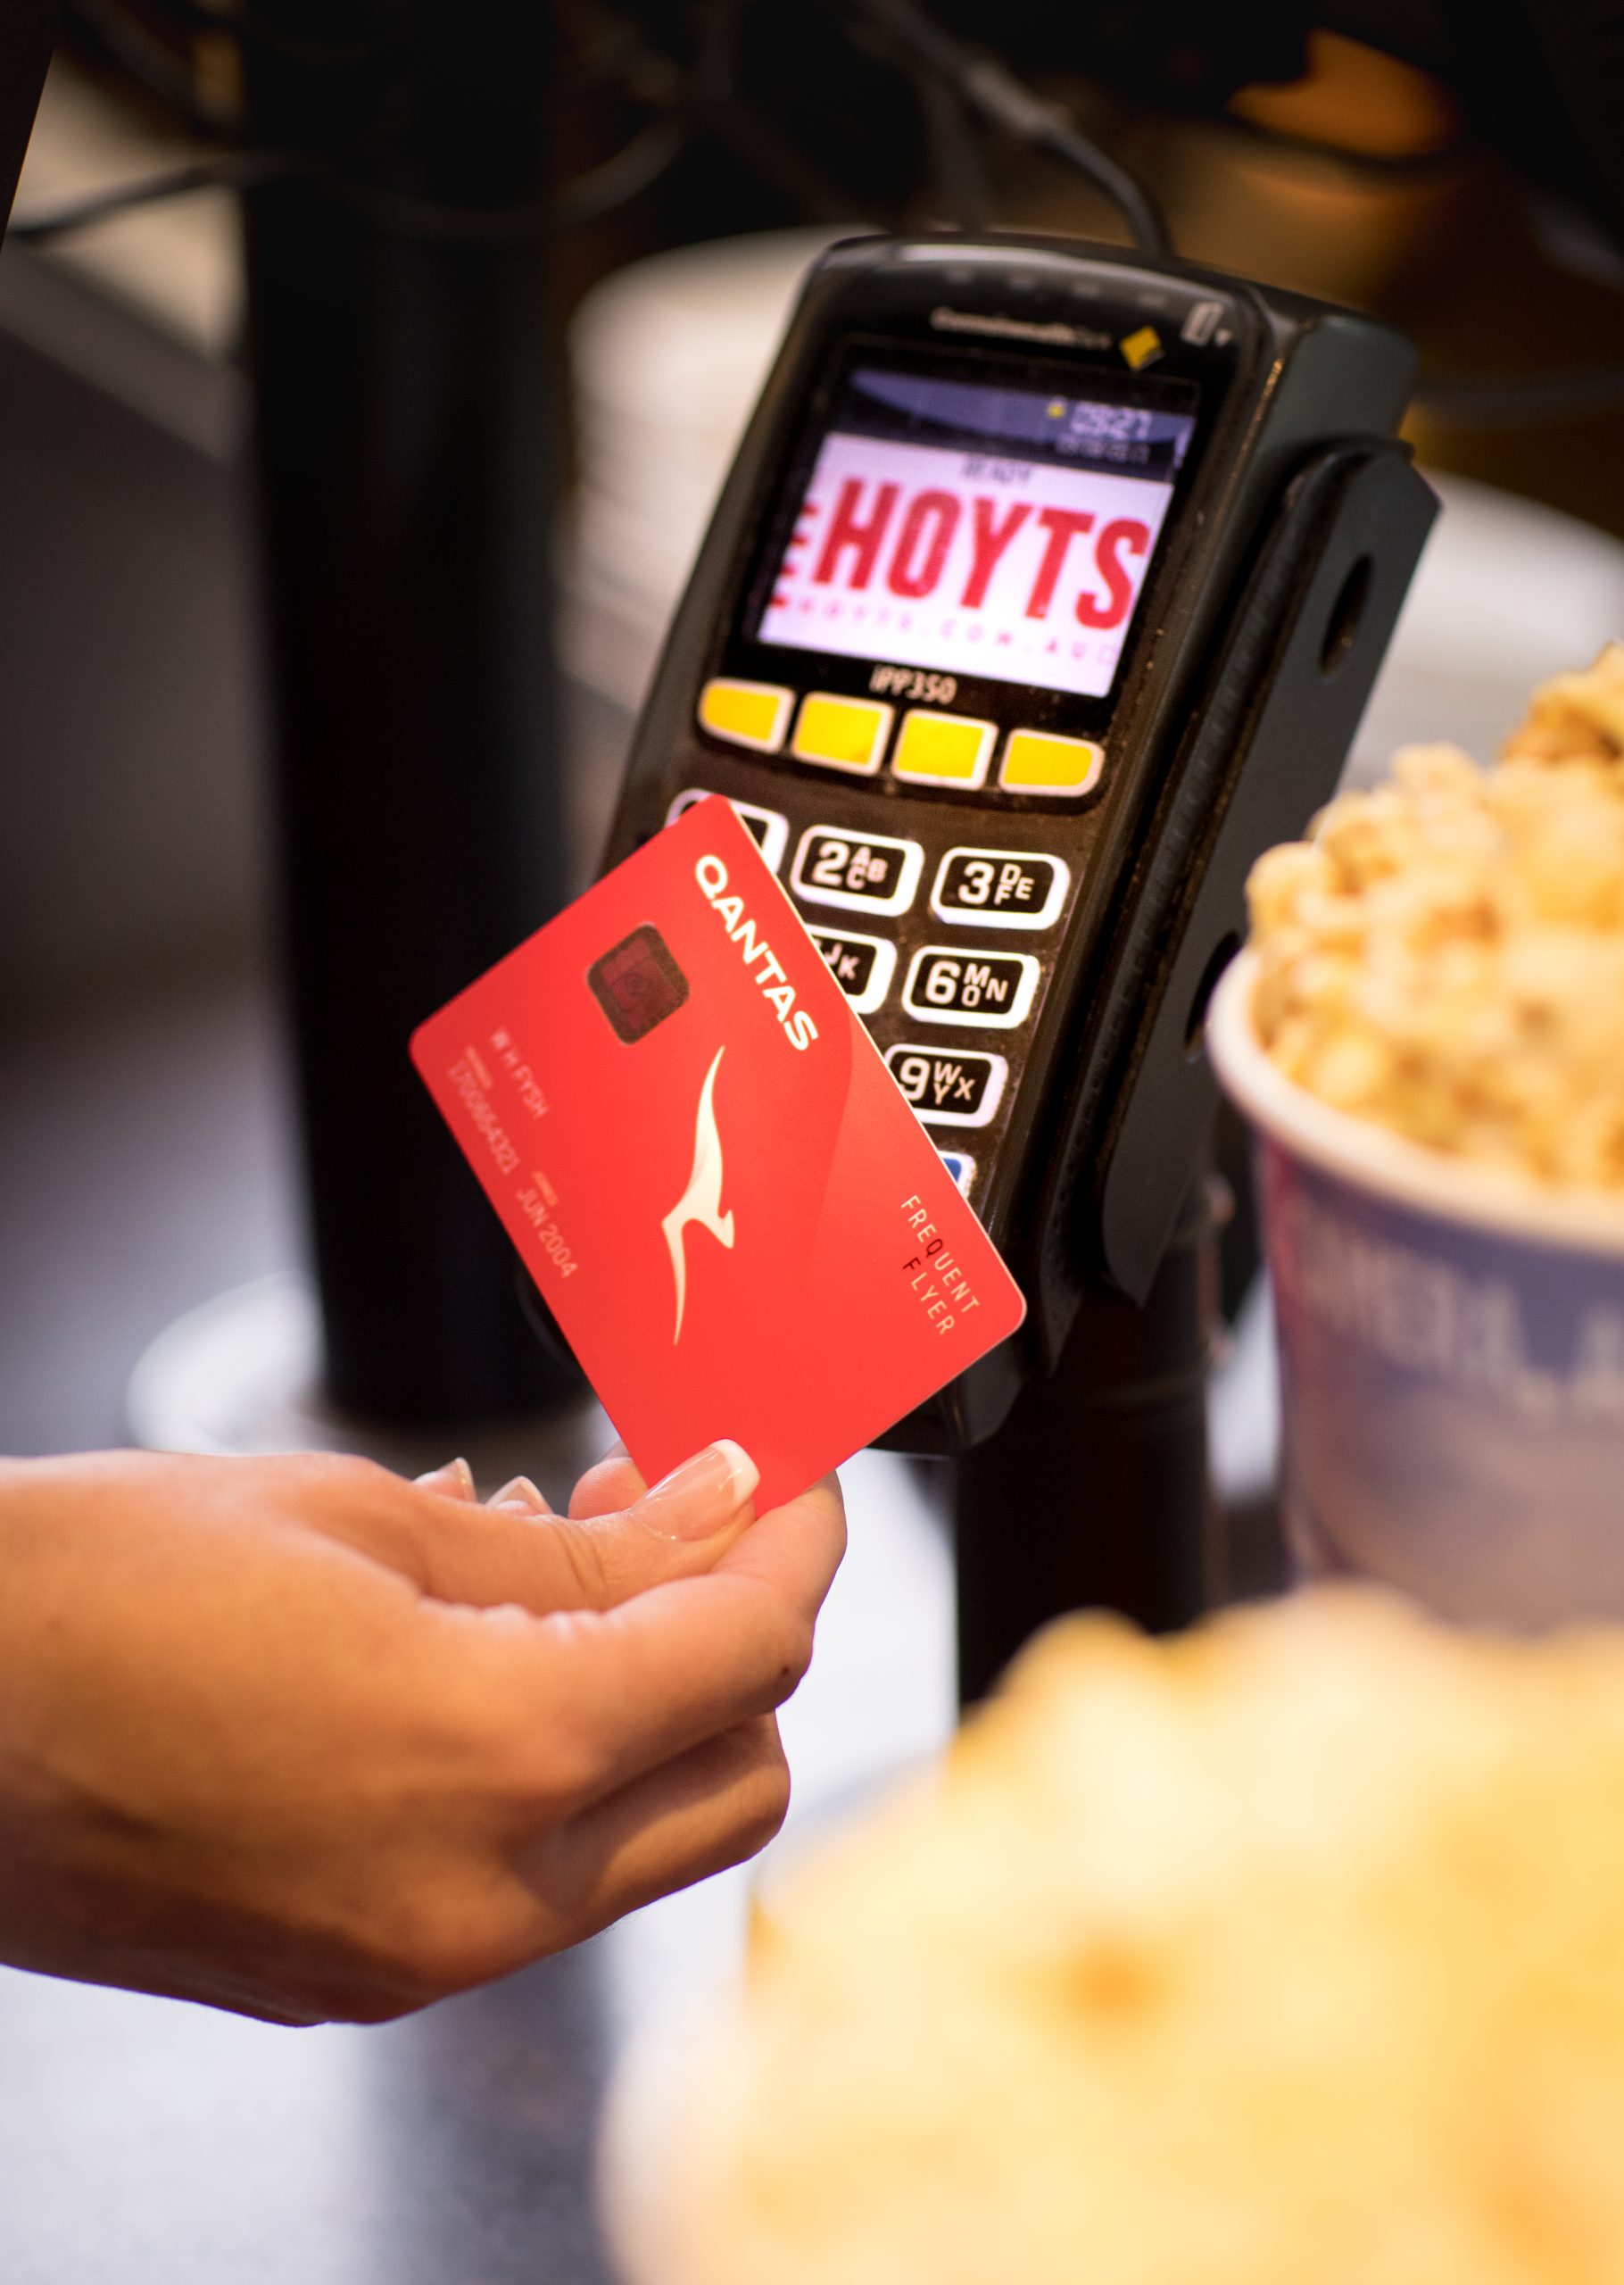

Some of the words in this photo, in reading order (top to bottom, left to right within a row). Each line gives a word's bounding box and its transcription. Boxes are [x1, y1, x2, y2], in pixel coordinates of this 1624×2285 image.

[813, 477, 1150, 630] HOYTS
[812, 841, 850, 886] 2
[958, 860, 995, 905] 3
[694, 854, 819, 1051] QANTAS
[925, 960, 961, 1005] 6
[899, 1057, 932, 1101] 9
[516, 1187, 548, 1226] JUN
[539, 1224, 578, 1278] 2004
[900, 1194, 981, 1314] FREQUENT
[902, 1256, 956, 1336] FLYER
